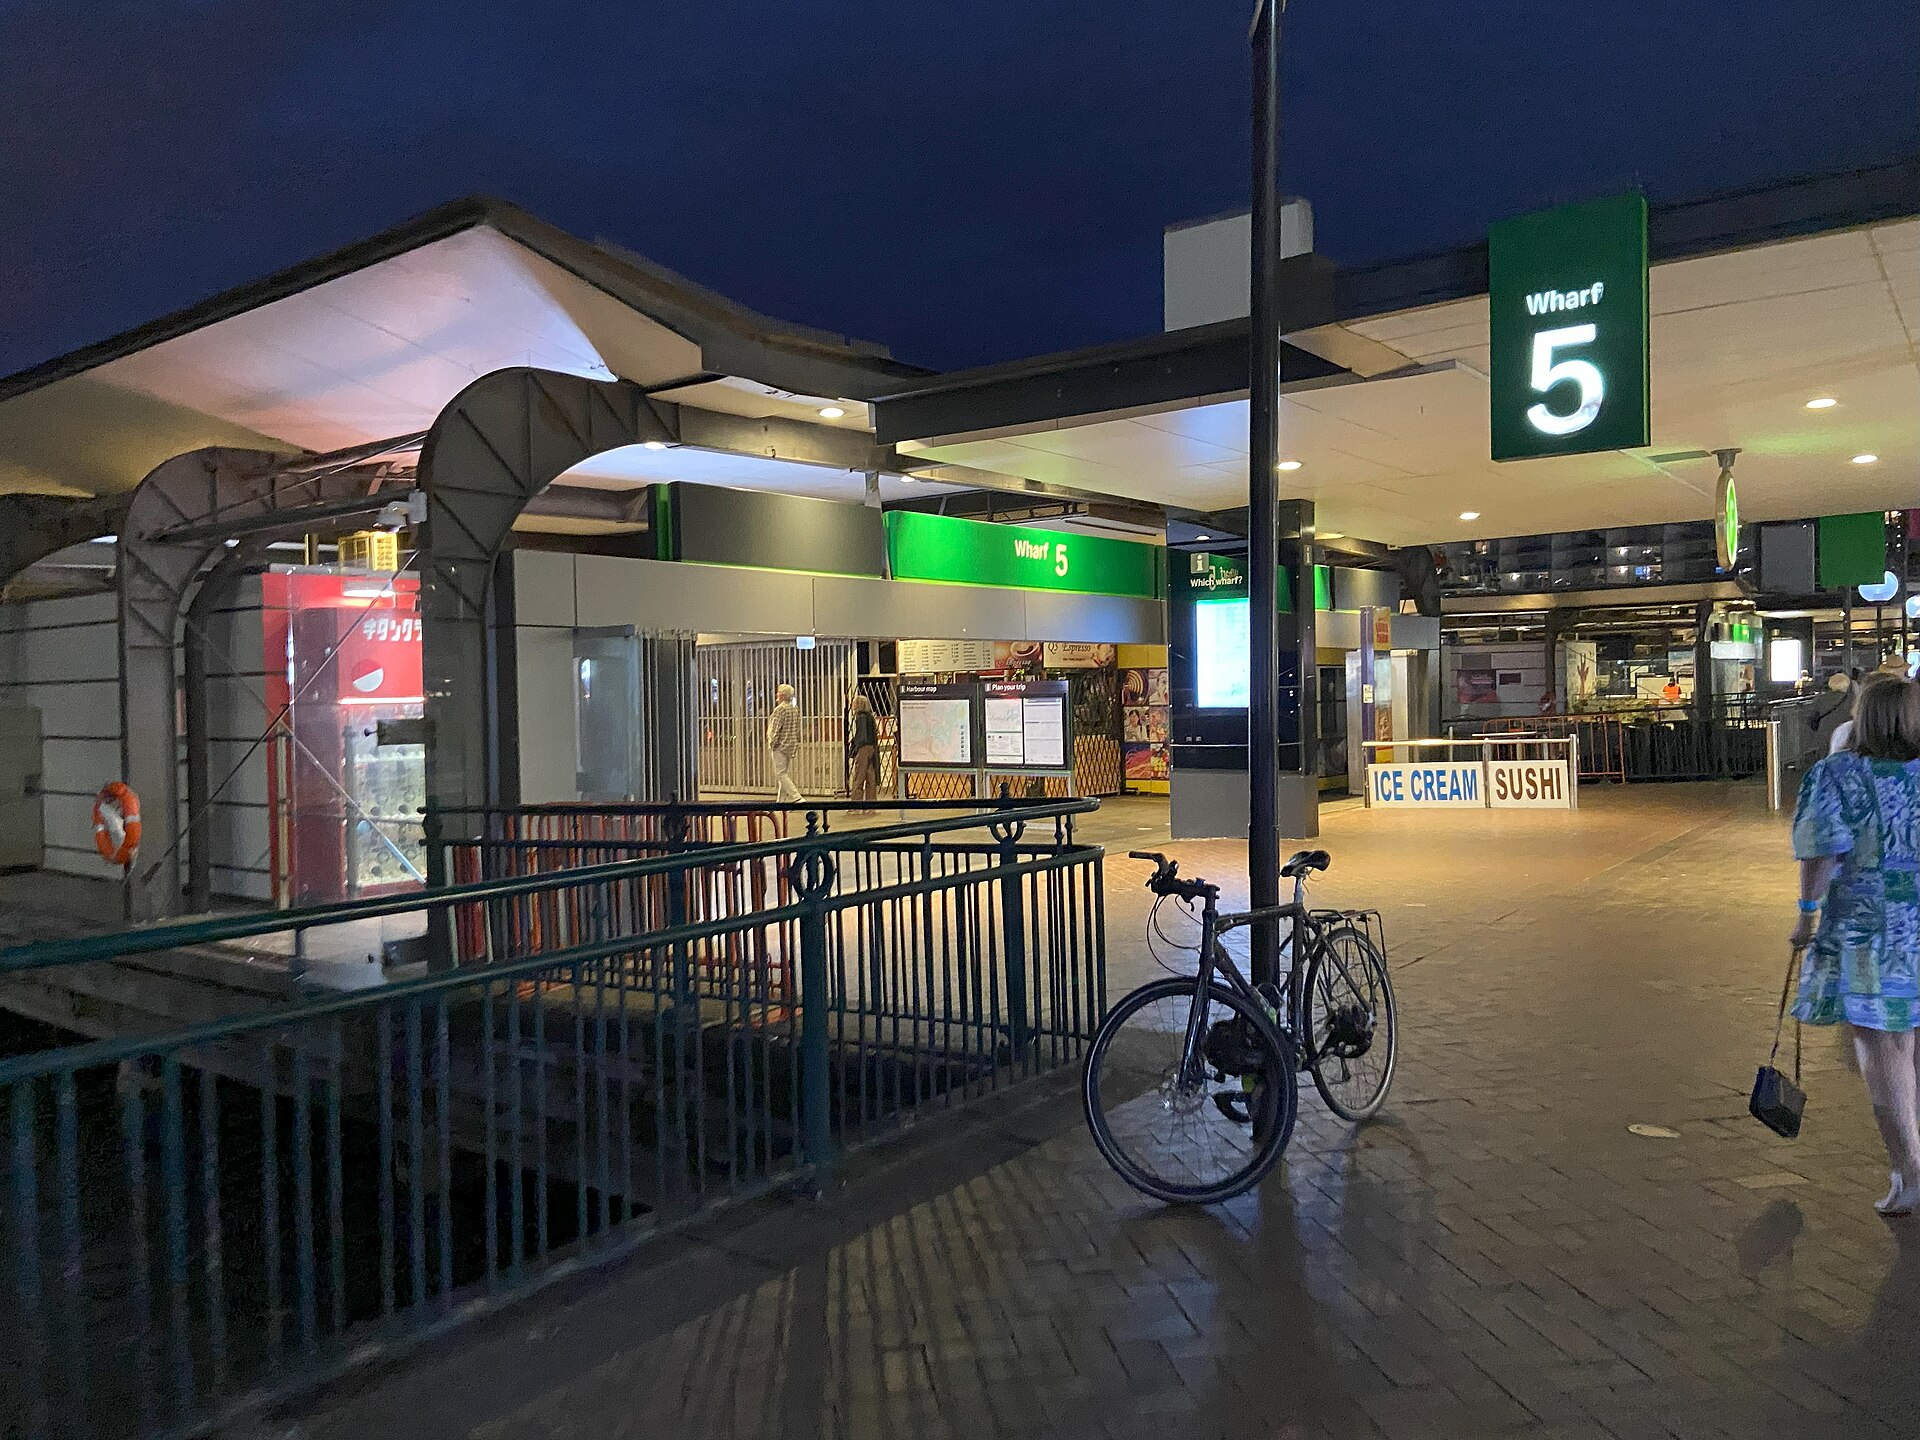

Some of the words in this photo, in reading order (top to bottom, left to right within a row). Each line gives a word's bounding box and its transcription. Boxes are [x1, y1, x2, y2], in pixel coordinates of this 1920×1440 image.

[1525, 281, 1605, 316] Wharf
[1526, 323, 1605, 435] 5
[1014, 539, 1050, 561] Wharf
[1055, 543, 1069, 577] 5
[1190, 577, 1214, 588] Which
[1215, 575, 1243, 586] wharf?
[992, 683, 1003, 691] Plan
[1016, 683, 1026, 692] trip
[1374, 770, 1404, 802] ICE
[1410, 769, 1478, 801] CREAM
[1495, 767, 1562, 801] SUSHI
